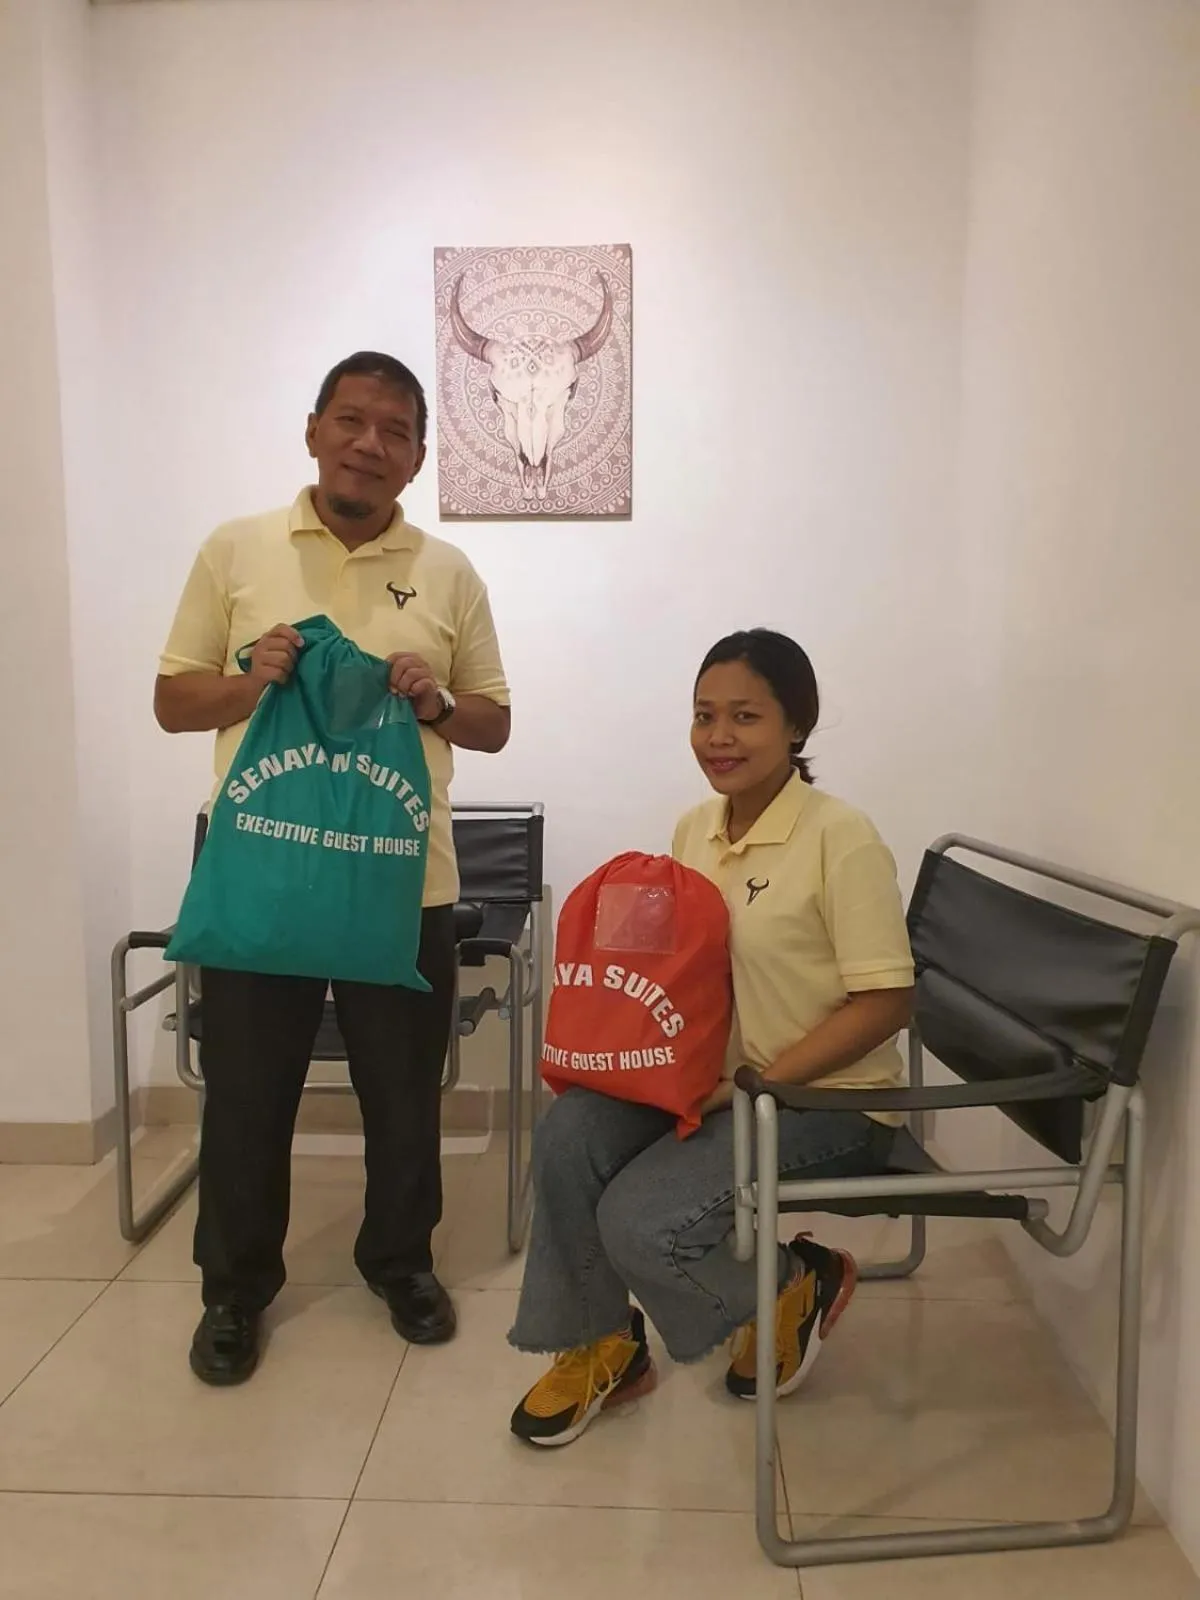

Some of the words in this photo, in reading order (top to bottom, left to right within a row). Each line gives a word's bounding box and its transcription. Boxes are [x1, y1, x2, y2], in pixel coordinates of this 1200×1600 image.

[356, 753, 430, 833] SUITES
[236, 812, 319, 845] EXECUTIVE
[323, 830, 368, 853] GUEST
[373, 836, 421, 856] HOUSE
[554, 963, 593, 987] YA
[603, 964, 685, 1038] SUITES
[571, 1052, 614, 1071] GUEST
[620, 1046, 676, 1070] HOUSE
